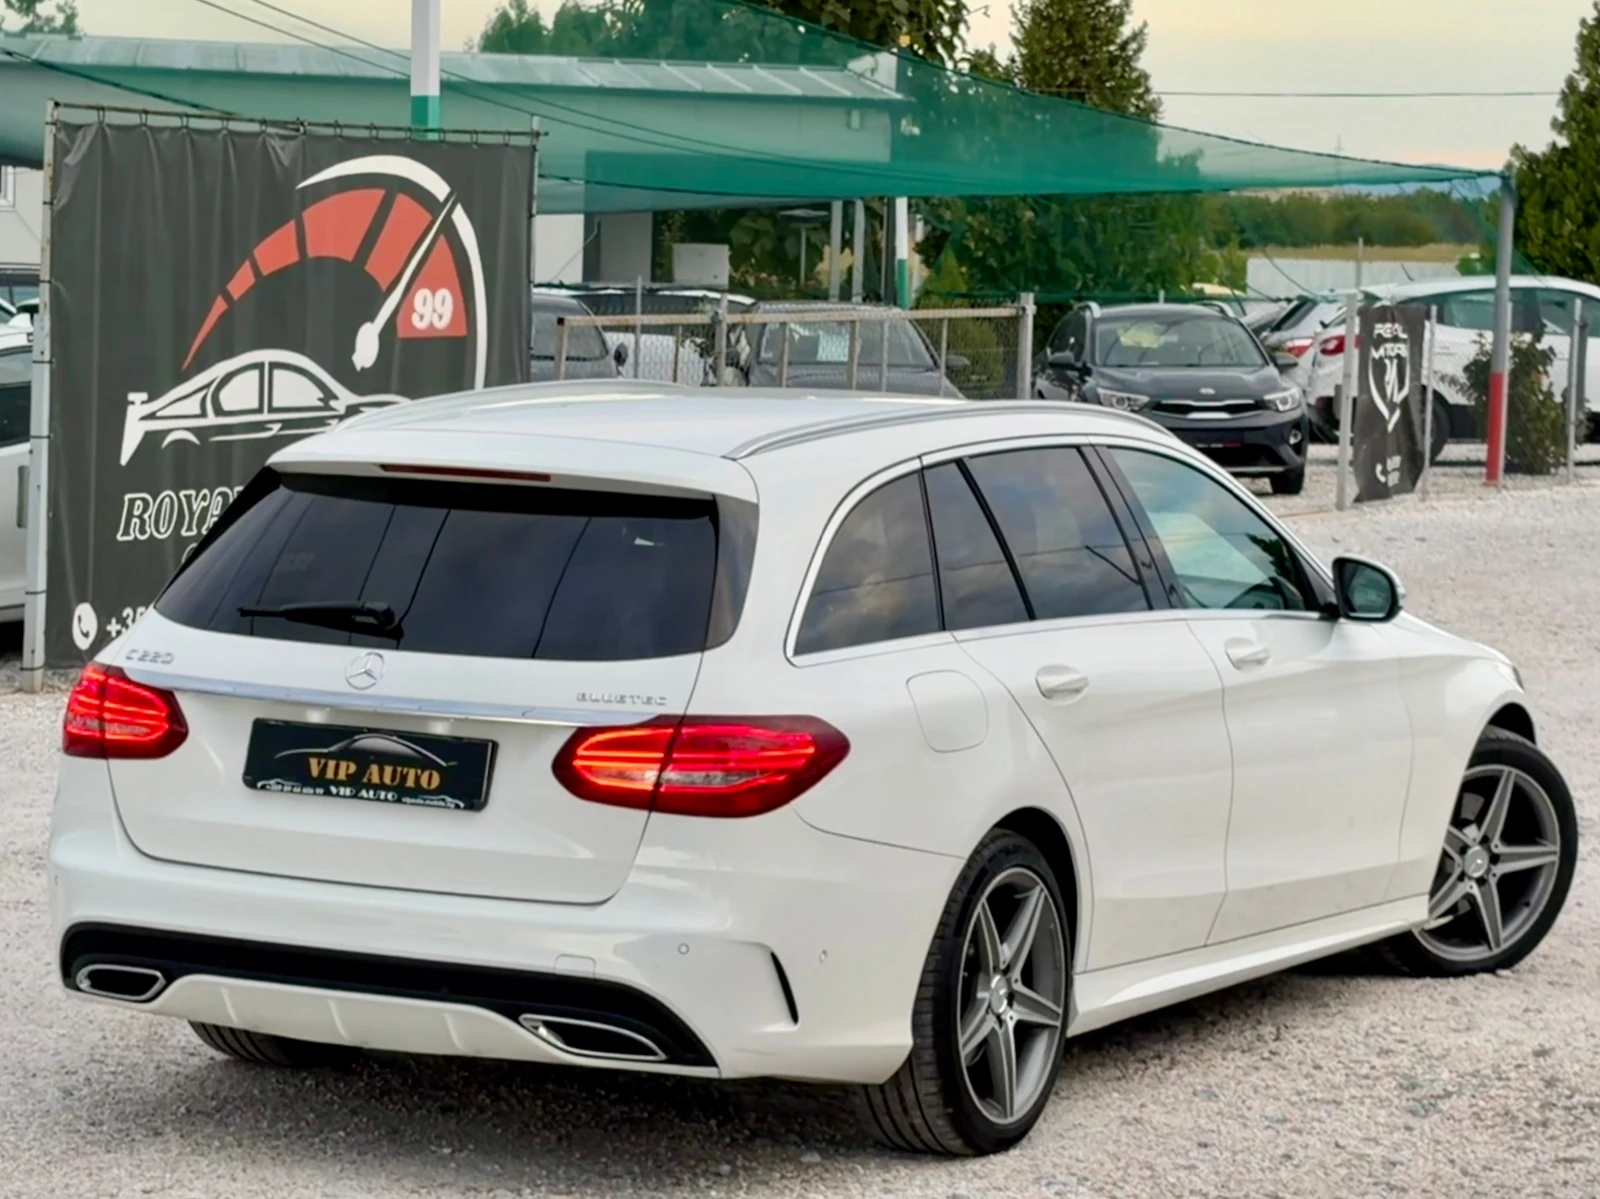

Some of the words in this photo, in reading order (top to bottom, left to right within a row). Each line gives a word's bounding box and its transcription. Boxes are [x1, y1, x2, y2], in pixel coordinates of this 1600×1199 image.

[411, 287, 453, 330] 99
[576, 692, 667, 706] BLUETEC
[308, 756, 357, 781] VIP
[362, 763, 441, 791] AUTO
[328, 784, 355, 797] VIP
[357, 788, 399, 802] AUTO
